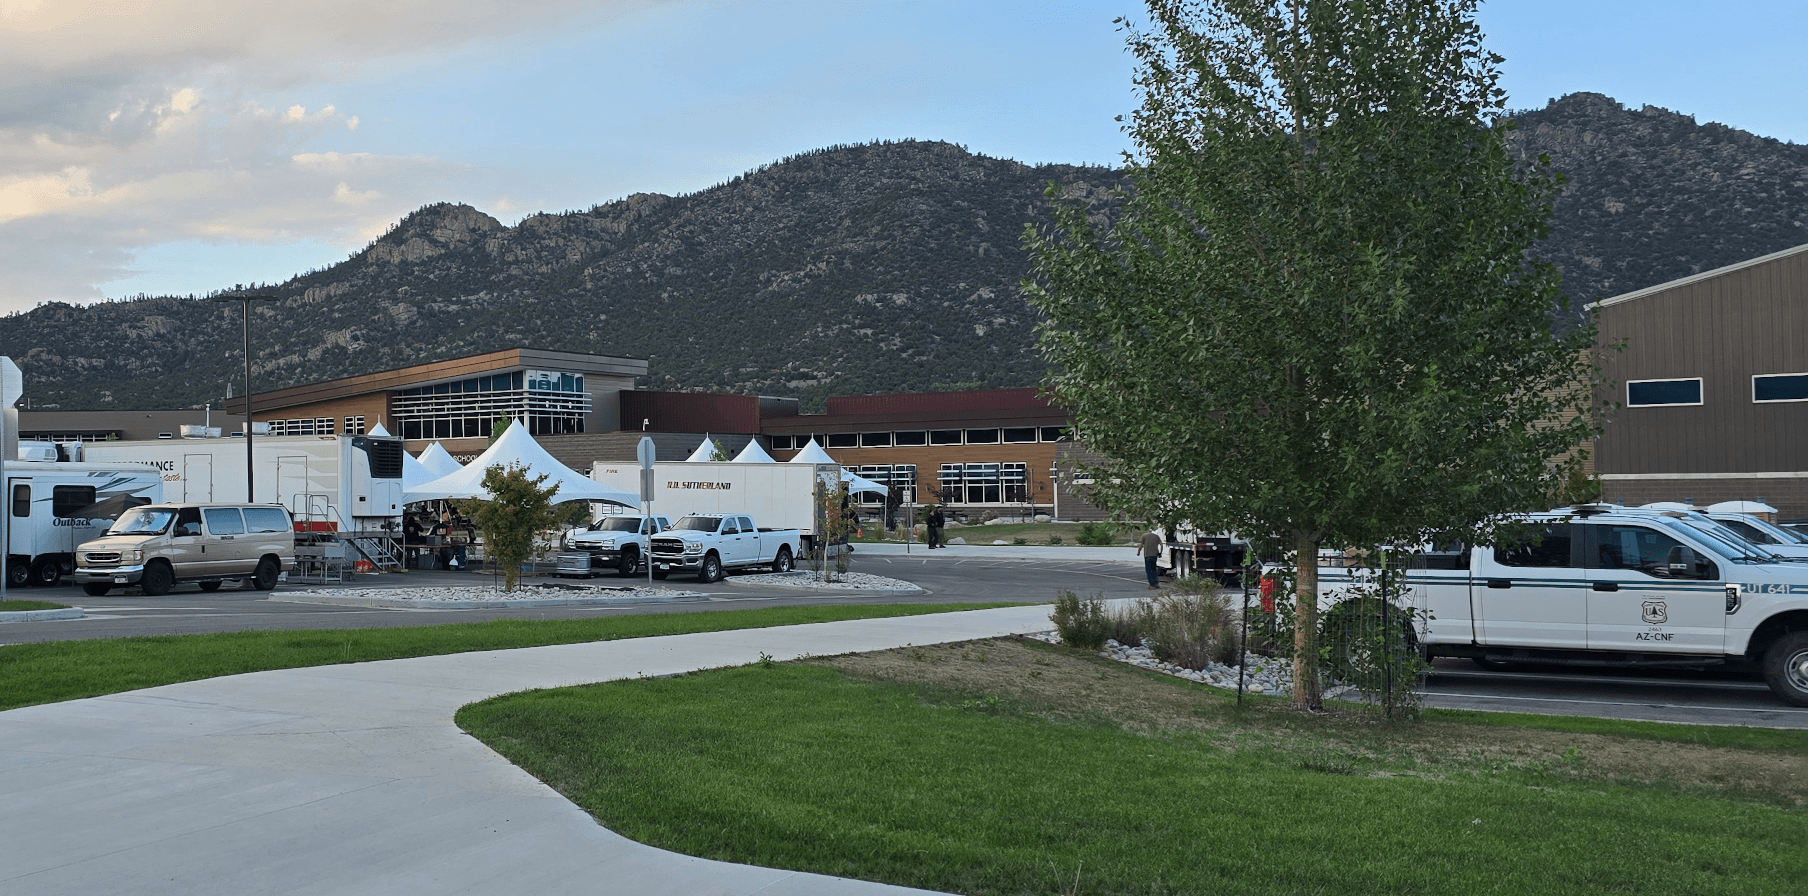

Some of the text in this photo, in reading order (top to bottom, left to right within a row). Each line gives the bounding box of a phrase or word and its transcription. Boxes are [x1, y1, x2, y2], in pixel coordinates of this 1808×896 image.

[682, 481, 732, 490] SUTHERLAND
[53, 517, 91, 527] Outback
[1747, 583, 1790, 594] UT 641
[1636, 632, 1675, 641] AZ-CNF
